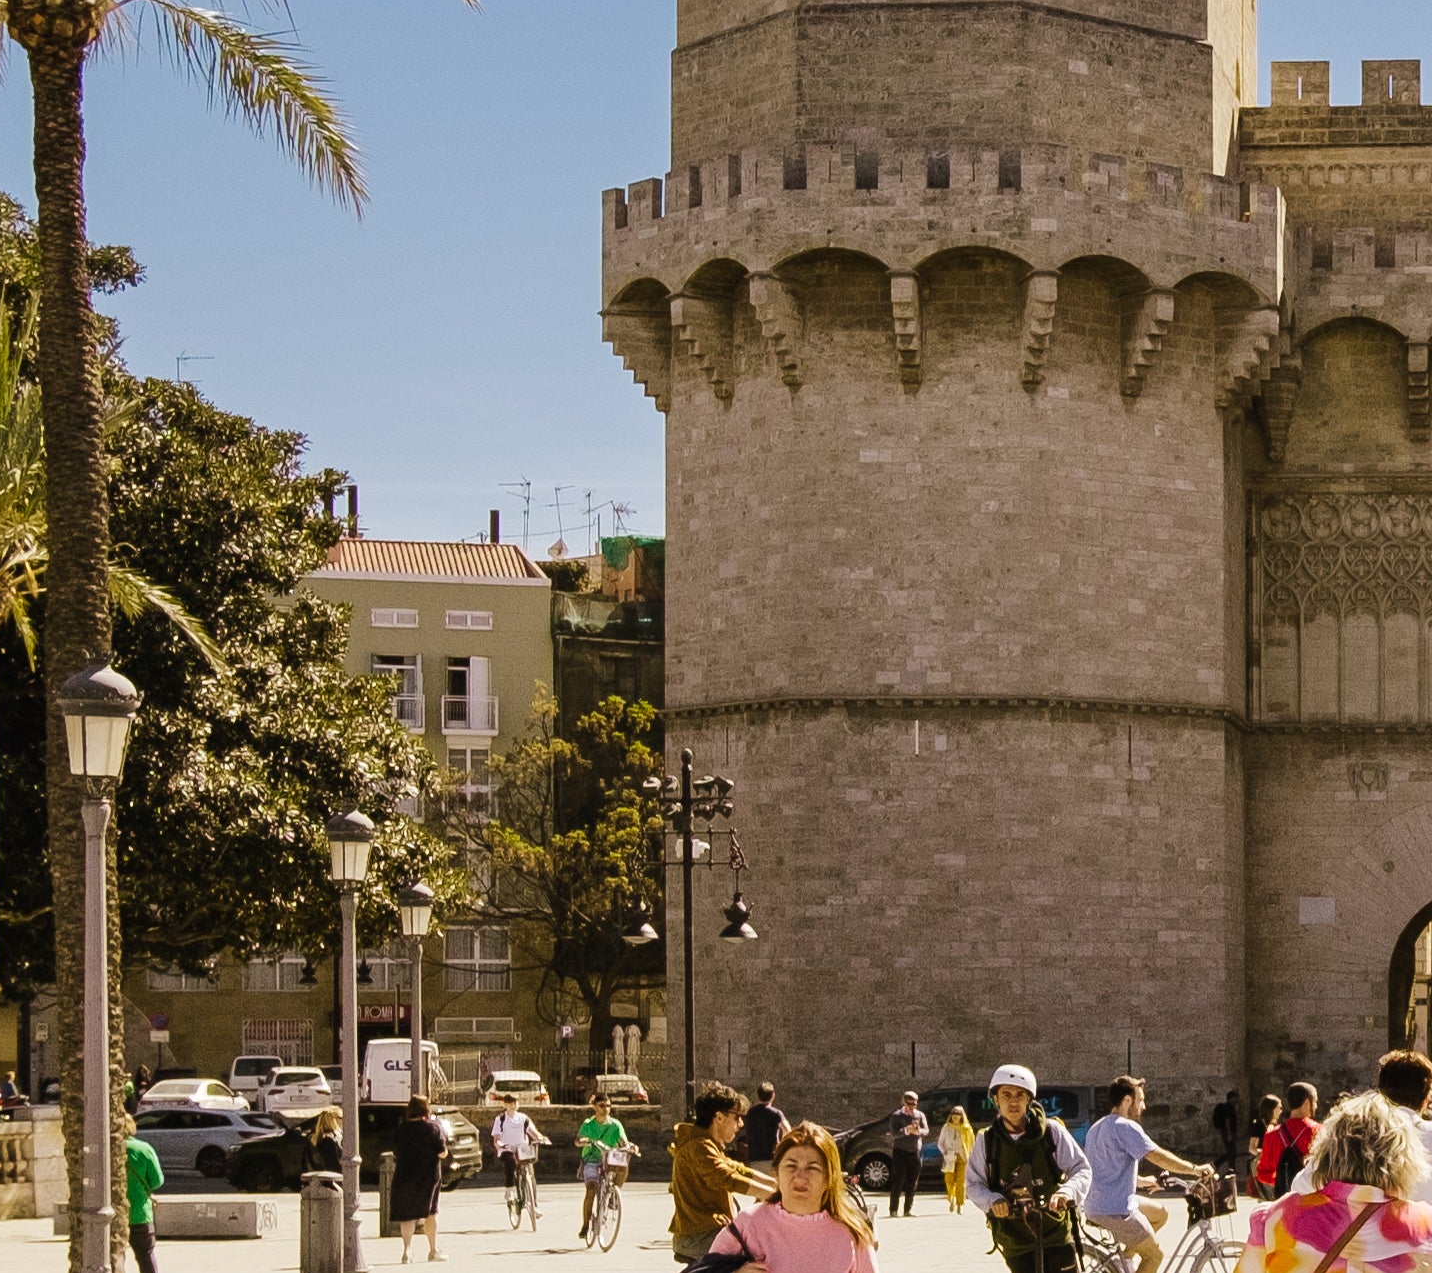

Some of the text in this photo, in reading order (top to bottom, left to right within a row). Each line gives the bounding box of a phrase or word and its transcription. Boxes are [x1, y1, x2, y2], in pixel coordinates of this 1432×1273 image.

[364, 1005, 393, 1020] ROMA
[562, 1025, 572, 1038] P
[384, 1059, 414, 1072] GLS
